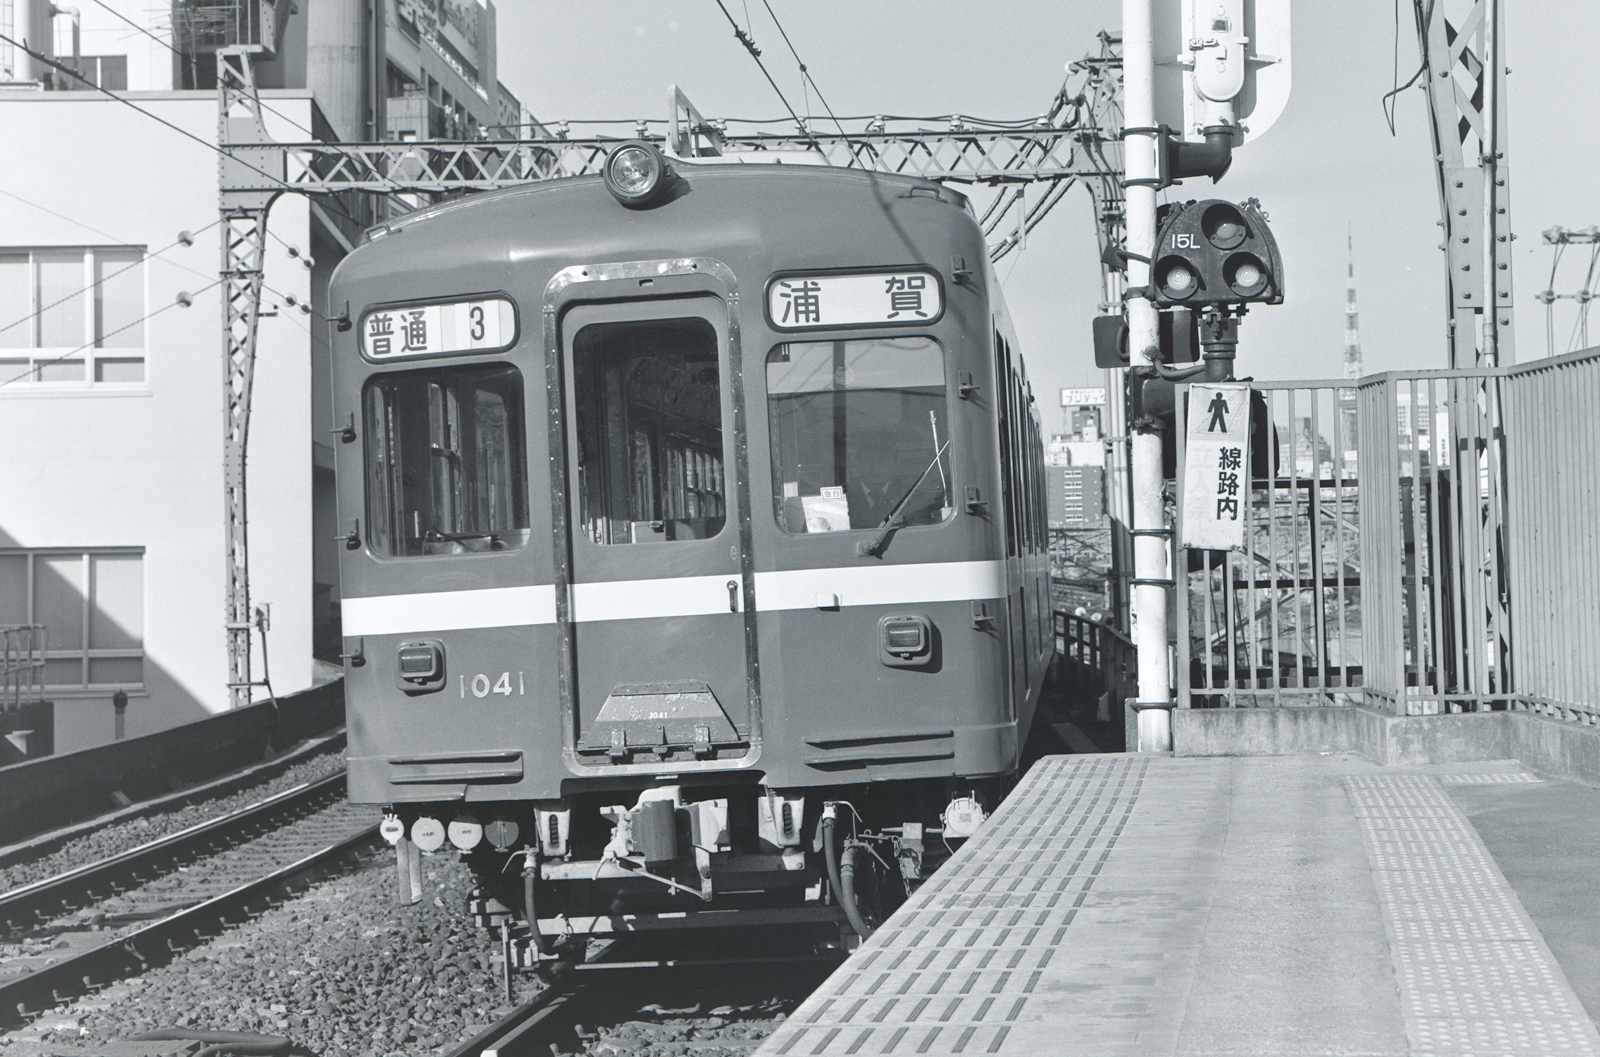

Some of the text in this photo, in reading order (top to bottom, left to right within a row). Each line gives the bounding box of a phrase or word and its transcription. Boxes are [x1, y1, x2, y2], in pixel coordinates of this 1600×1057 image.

[1171, 233, 1201, 249] 15L
[779, 276, 928, 323] 浦賀
[368, 305, 485, 356] 普通 3
[1216, 446, 1242, 521] 線路内
[459, 671, 525, 699] 1041
[649, 711, 668, 719] 1041
